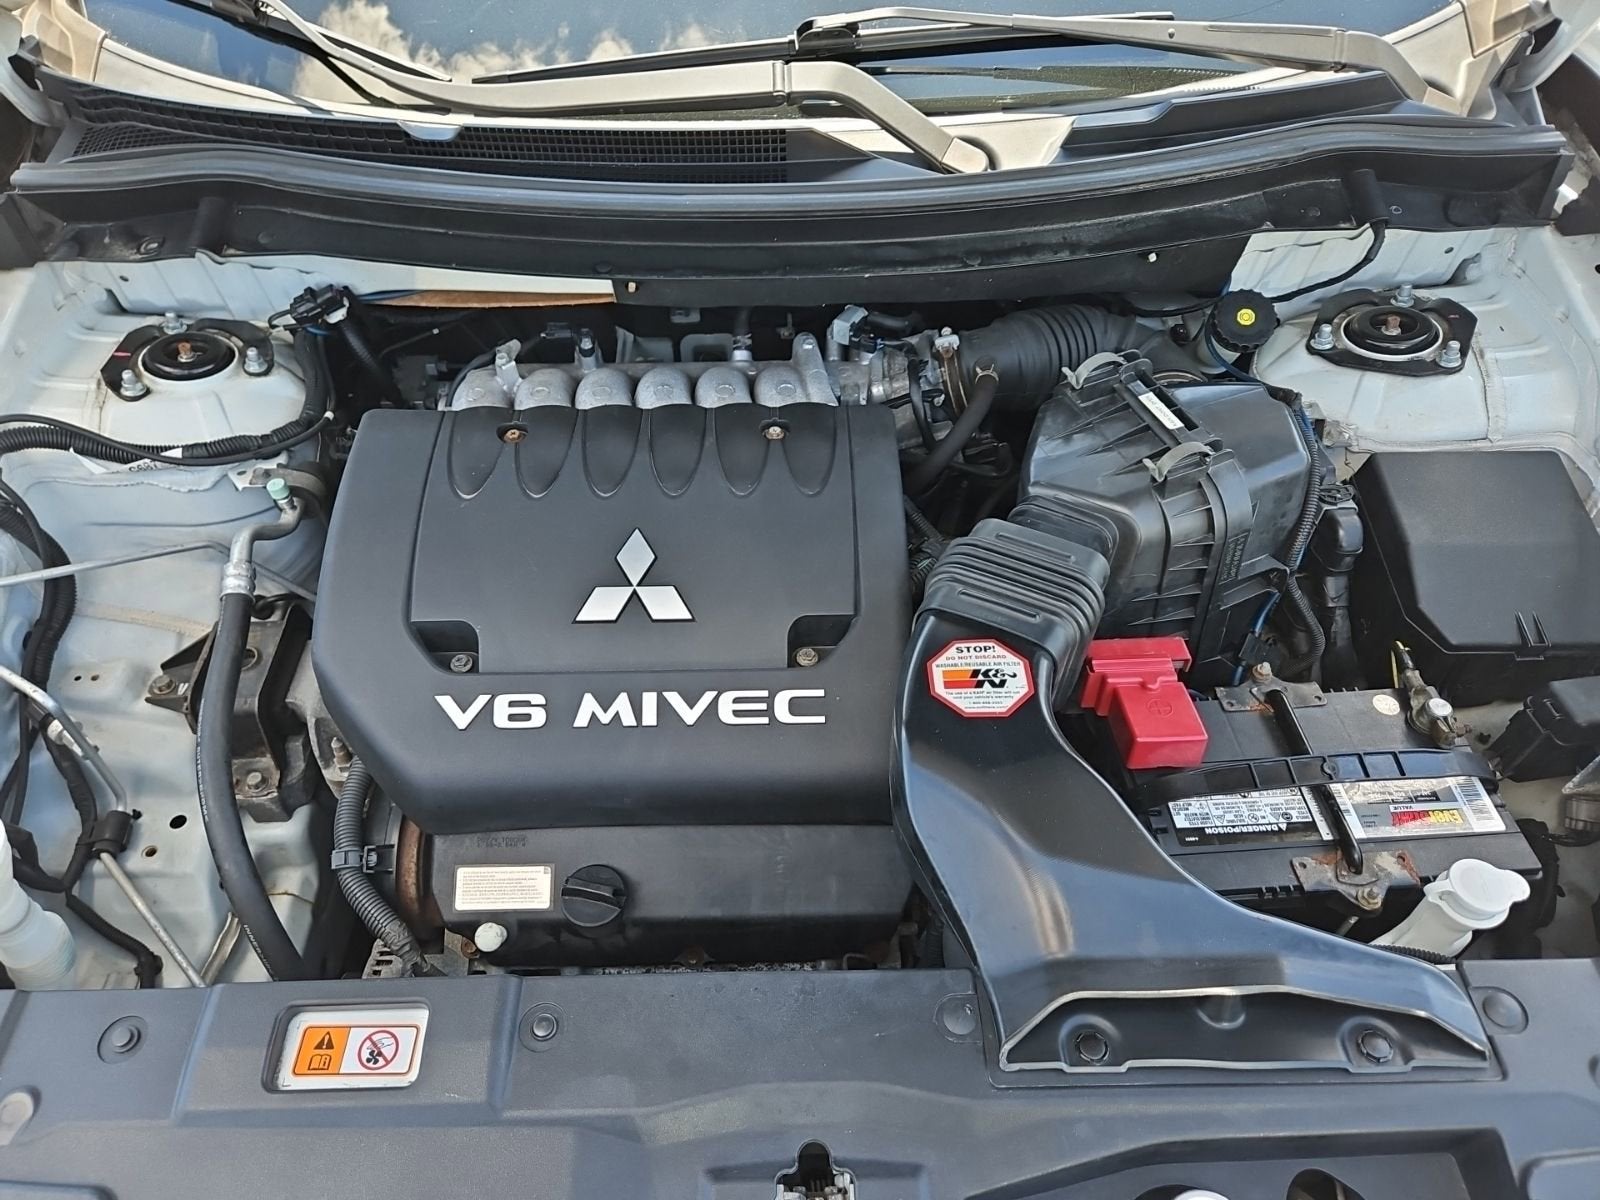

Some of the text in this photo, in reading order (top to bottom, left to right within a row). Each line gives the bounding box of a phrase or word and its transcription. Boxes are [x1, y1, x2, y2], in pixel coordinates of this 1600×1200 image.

[955, 645, 996, 653] STOP!
[434, 688, 826, 730] V6 MIVEC
[1205, 824, 1278, 834] DANGER/POISON
